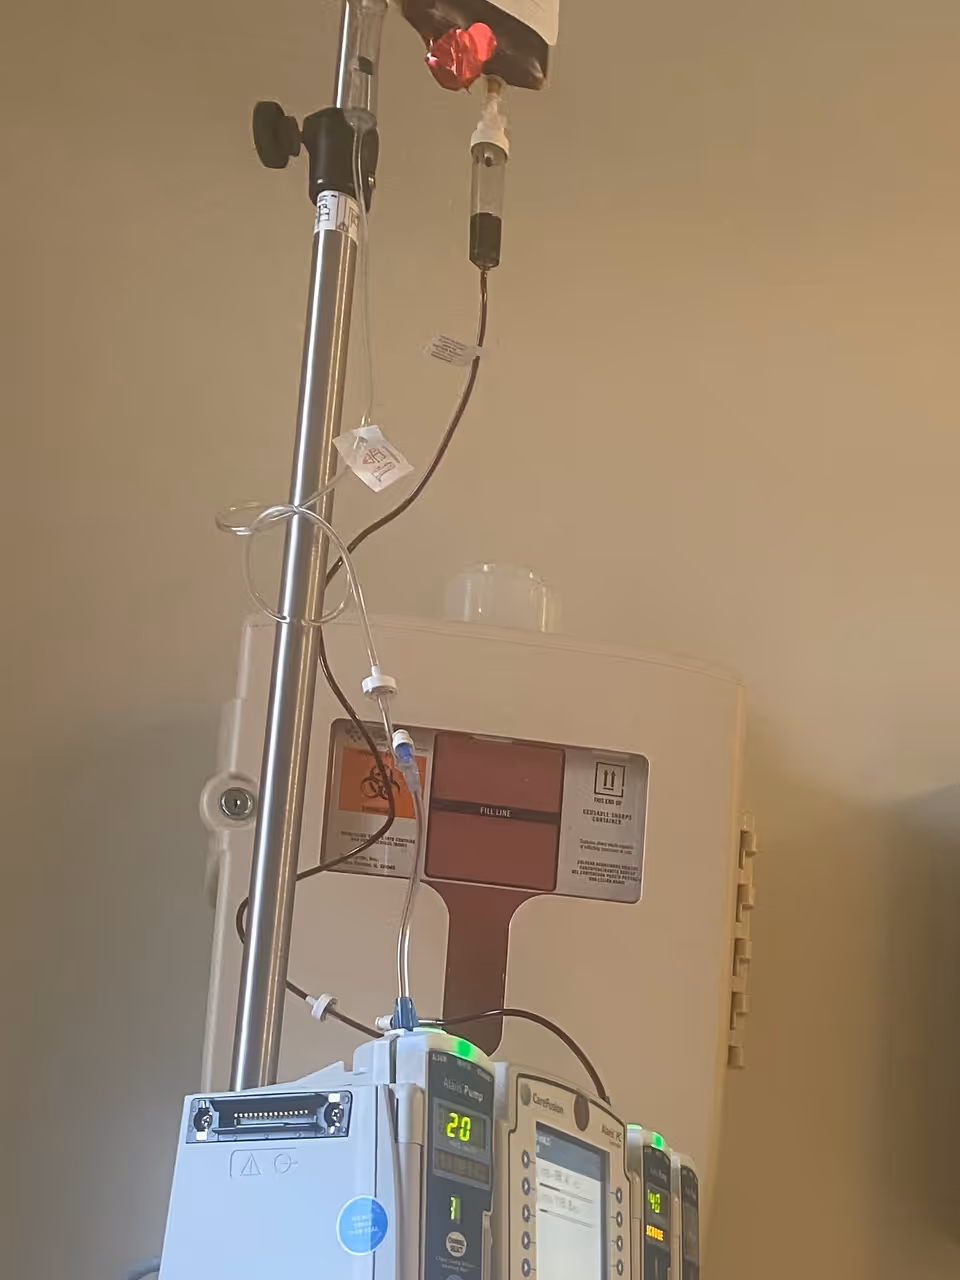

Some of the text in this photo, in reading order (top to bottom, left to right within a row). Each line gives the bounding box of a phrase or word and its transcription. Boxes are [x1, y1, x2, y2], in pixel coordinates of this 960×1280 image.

[480, 806, 511, 817] FILL LINE
[464, 1084, 483, 1103] Pump
[532, 1092, 564, 1115] CareFusion
[446, 1112, 471, 1142] 20
